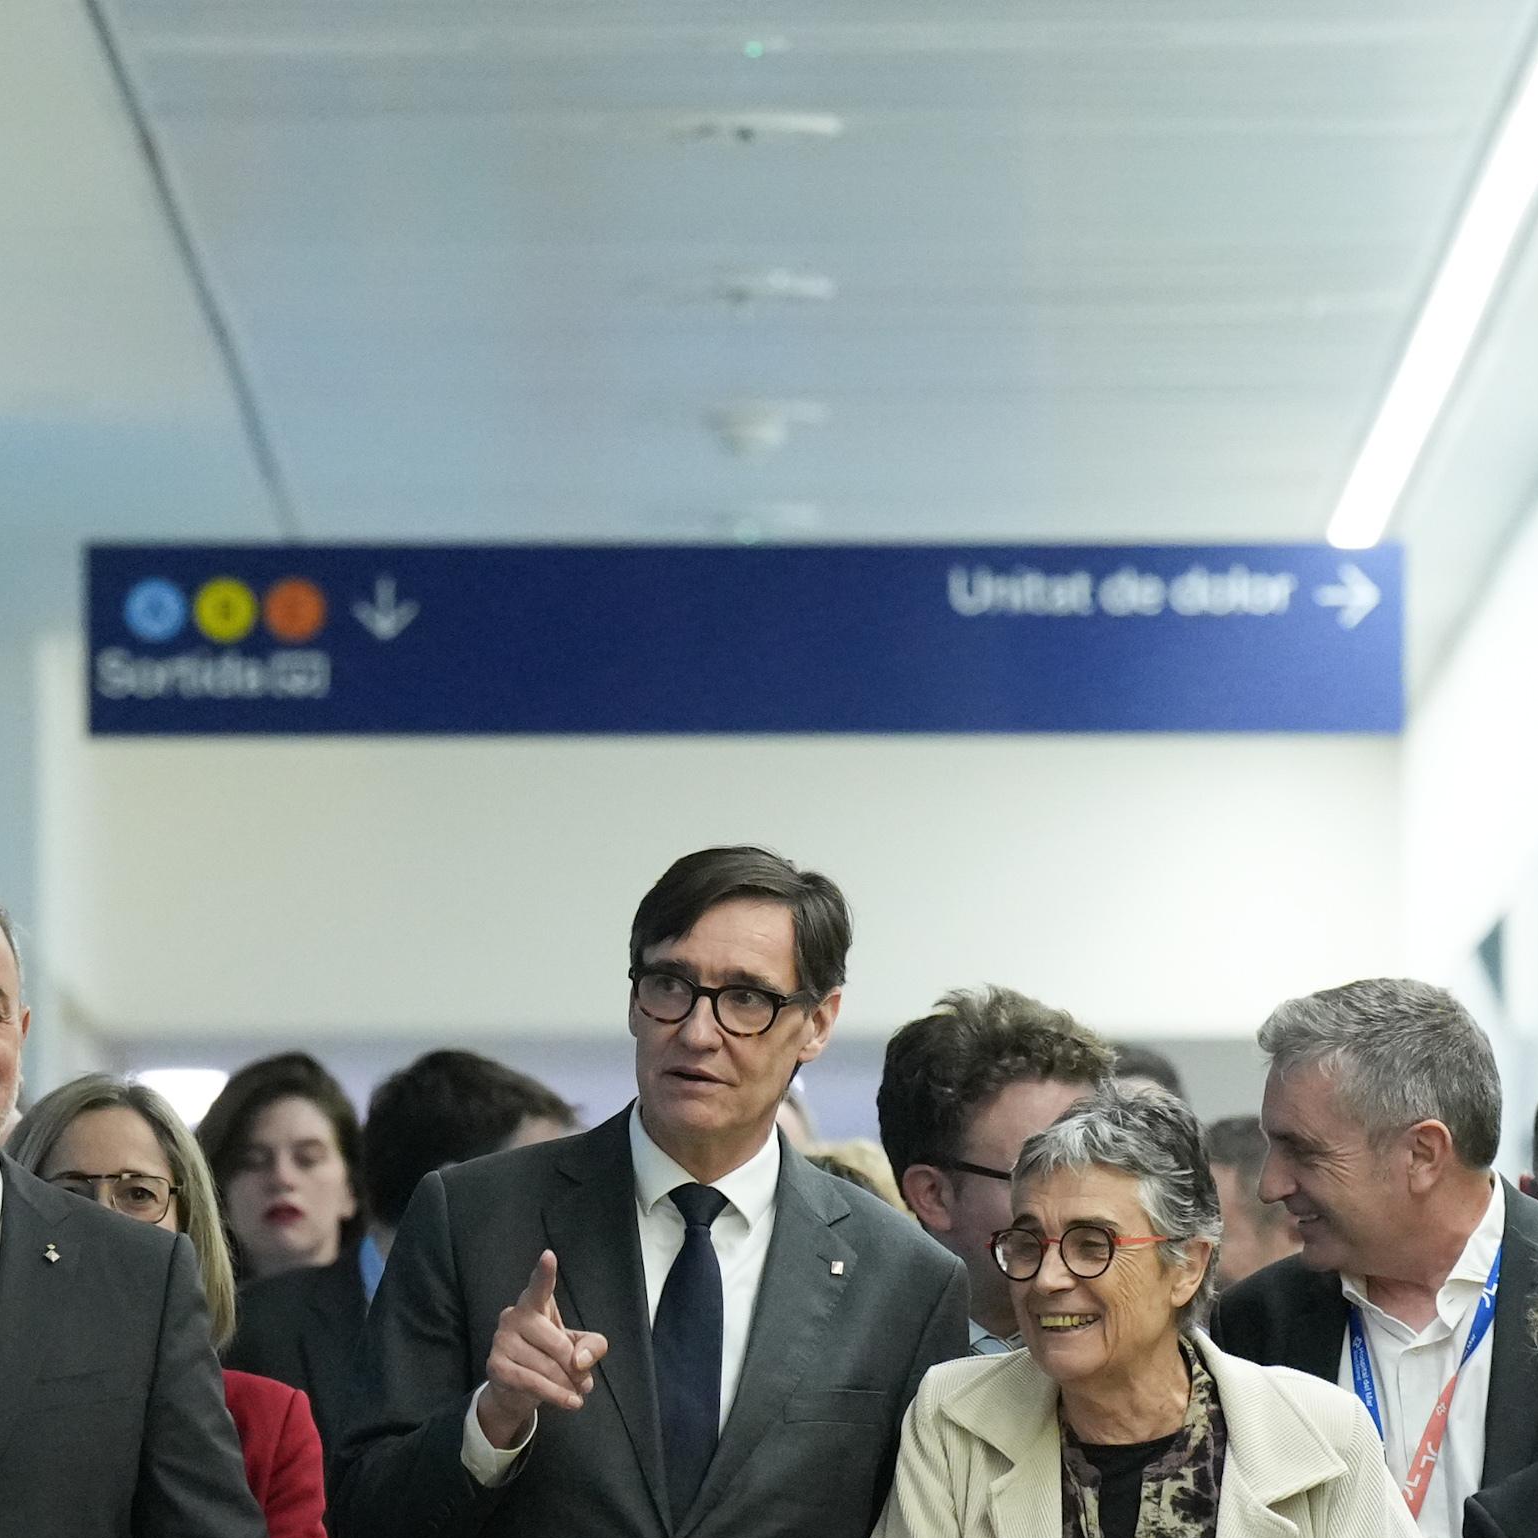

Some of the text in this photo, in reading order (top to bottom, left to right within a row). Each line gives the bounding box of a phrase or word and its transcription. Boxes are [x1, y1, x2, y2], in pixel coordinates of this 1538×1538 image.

[948, 564, 1095, 617] Unitat
[1099, 564, 1164, 617] de
[1358, 1346, 1369, 1379] Hospital
[1365, 1391, 1374, 1408] Mar
